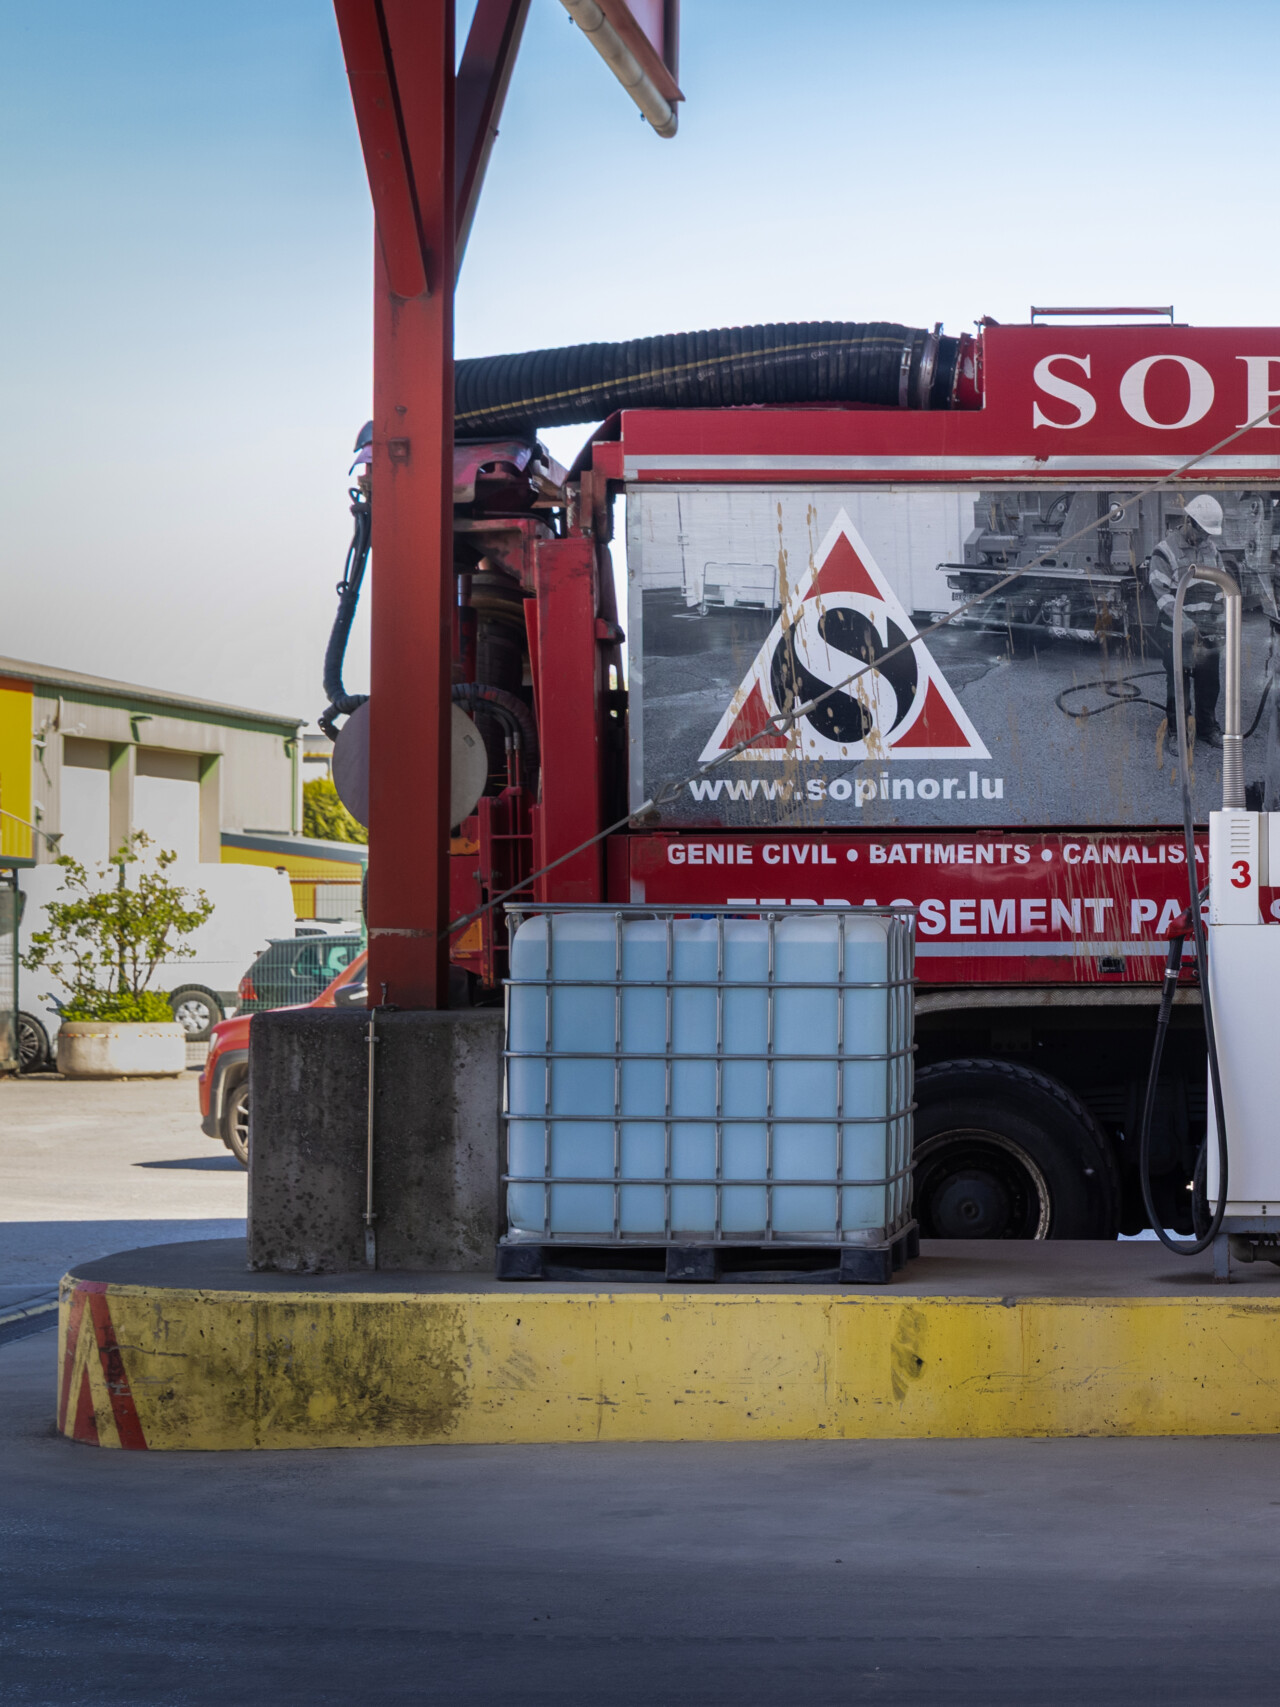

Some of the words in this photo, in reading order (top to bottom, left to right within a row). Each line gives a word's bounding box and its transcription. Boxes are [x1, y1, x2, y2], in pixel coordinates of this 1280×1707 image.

[688, 771, 1004, 807] www.sopinor.lu
[667, 843, 753, 865] GENIE
[762, 844, 837, 865] CIVIL
[869, 843, 1031, 865] BATIMENTS
[1062, 842, 1209, 865] CANALISA
[1230, 860, 1252, 888] 3
